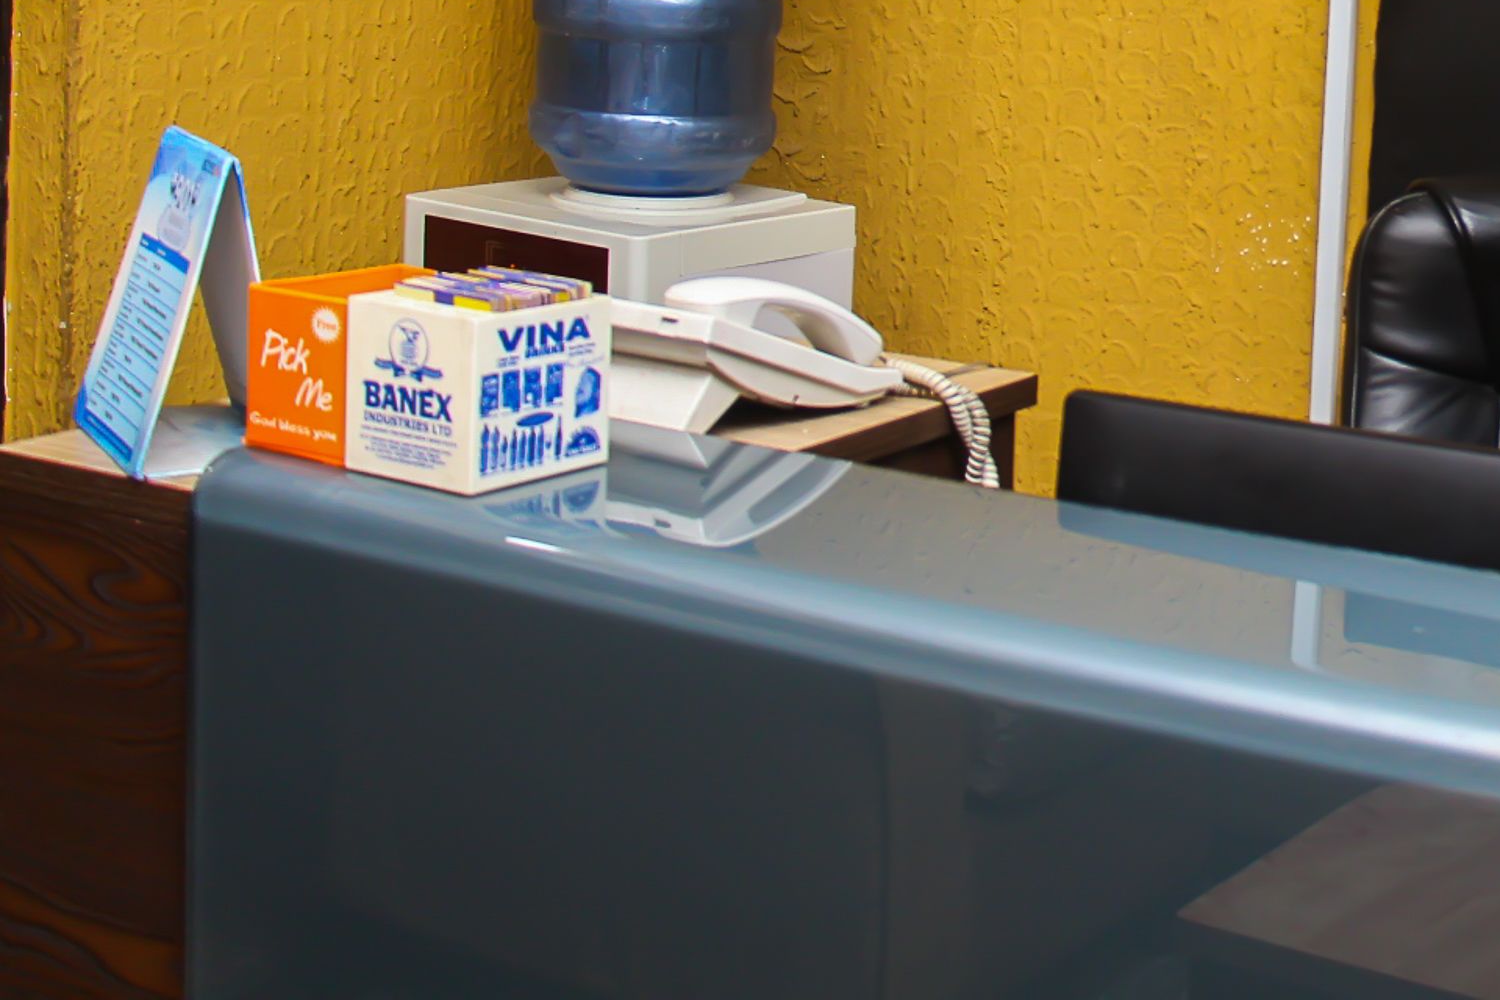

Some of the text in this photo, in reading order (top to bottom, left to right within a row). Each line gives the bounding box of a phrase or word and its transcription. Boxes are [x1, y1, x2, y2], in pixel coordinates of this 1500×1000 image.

[260, 327, 311, 376] Pick
[497, 316, 592, 353] VINA
[294, 376, 334, 412] Me
[363, 379, 453, 423] BANEX
[249, 410, 277, 429] God
[277, 417, 311, 437] bless
[311, 427, 338, 443] you
[363, 410, 430, 434] INDUSTRIES
[431, 424, 453, 438] LTD
